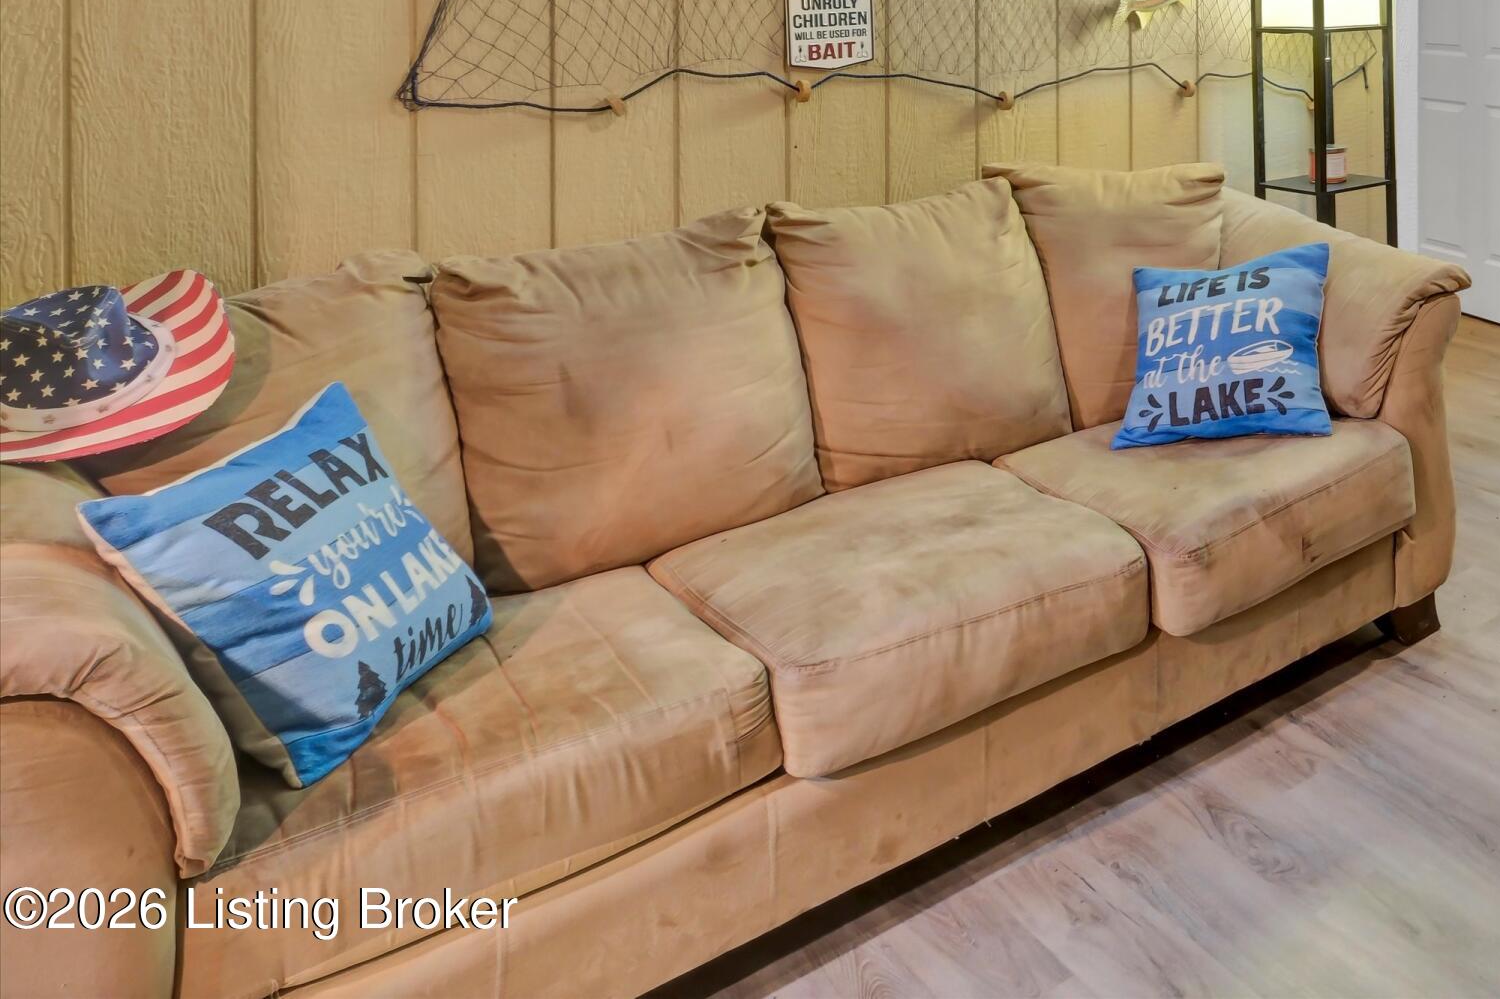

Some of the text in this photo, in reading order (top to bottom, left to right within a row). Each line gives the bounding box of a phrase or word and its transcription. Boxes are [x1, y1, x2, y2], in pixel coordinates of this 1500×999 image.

[792, 11, 868, 29] CHILDREN
[794, 28, 867, 41] WILL BE USED FOR
[808, 41, 856, 61] BAIT
[1157, 266, 1271, 308] LIFE IS
[1144, 296, 1285, 357] BETTER
[1143, 344, 1227, 389] at the
[1168, 378, 1266, 427] LAKE
[202, 432, 389, 561] RELAX
[303, 527, 464, 659] ON LAKE
[393, 602, 464, 684] time
